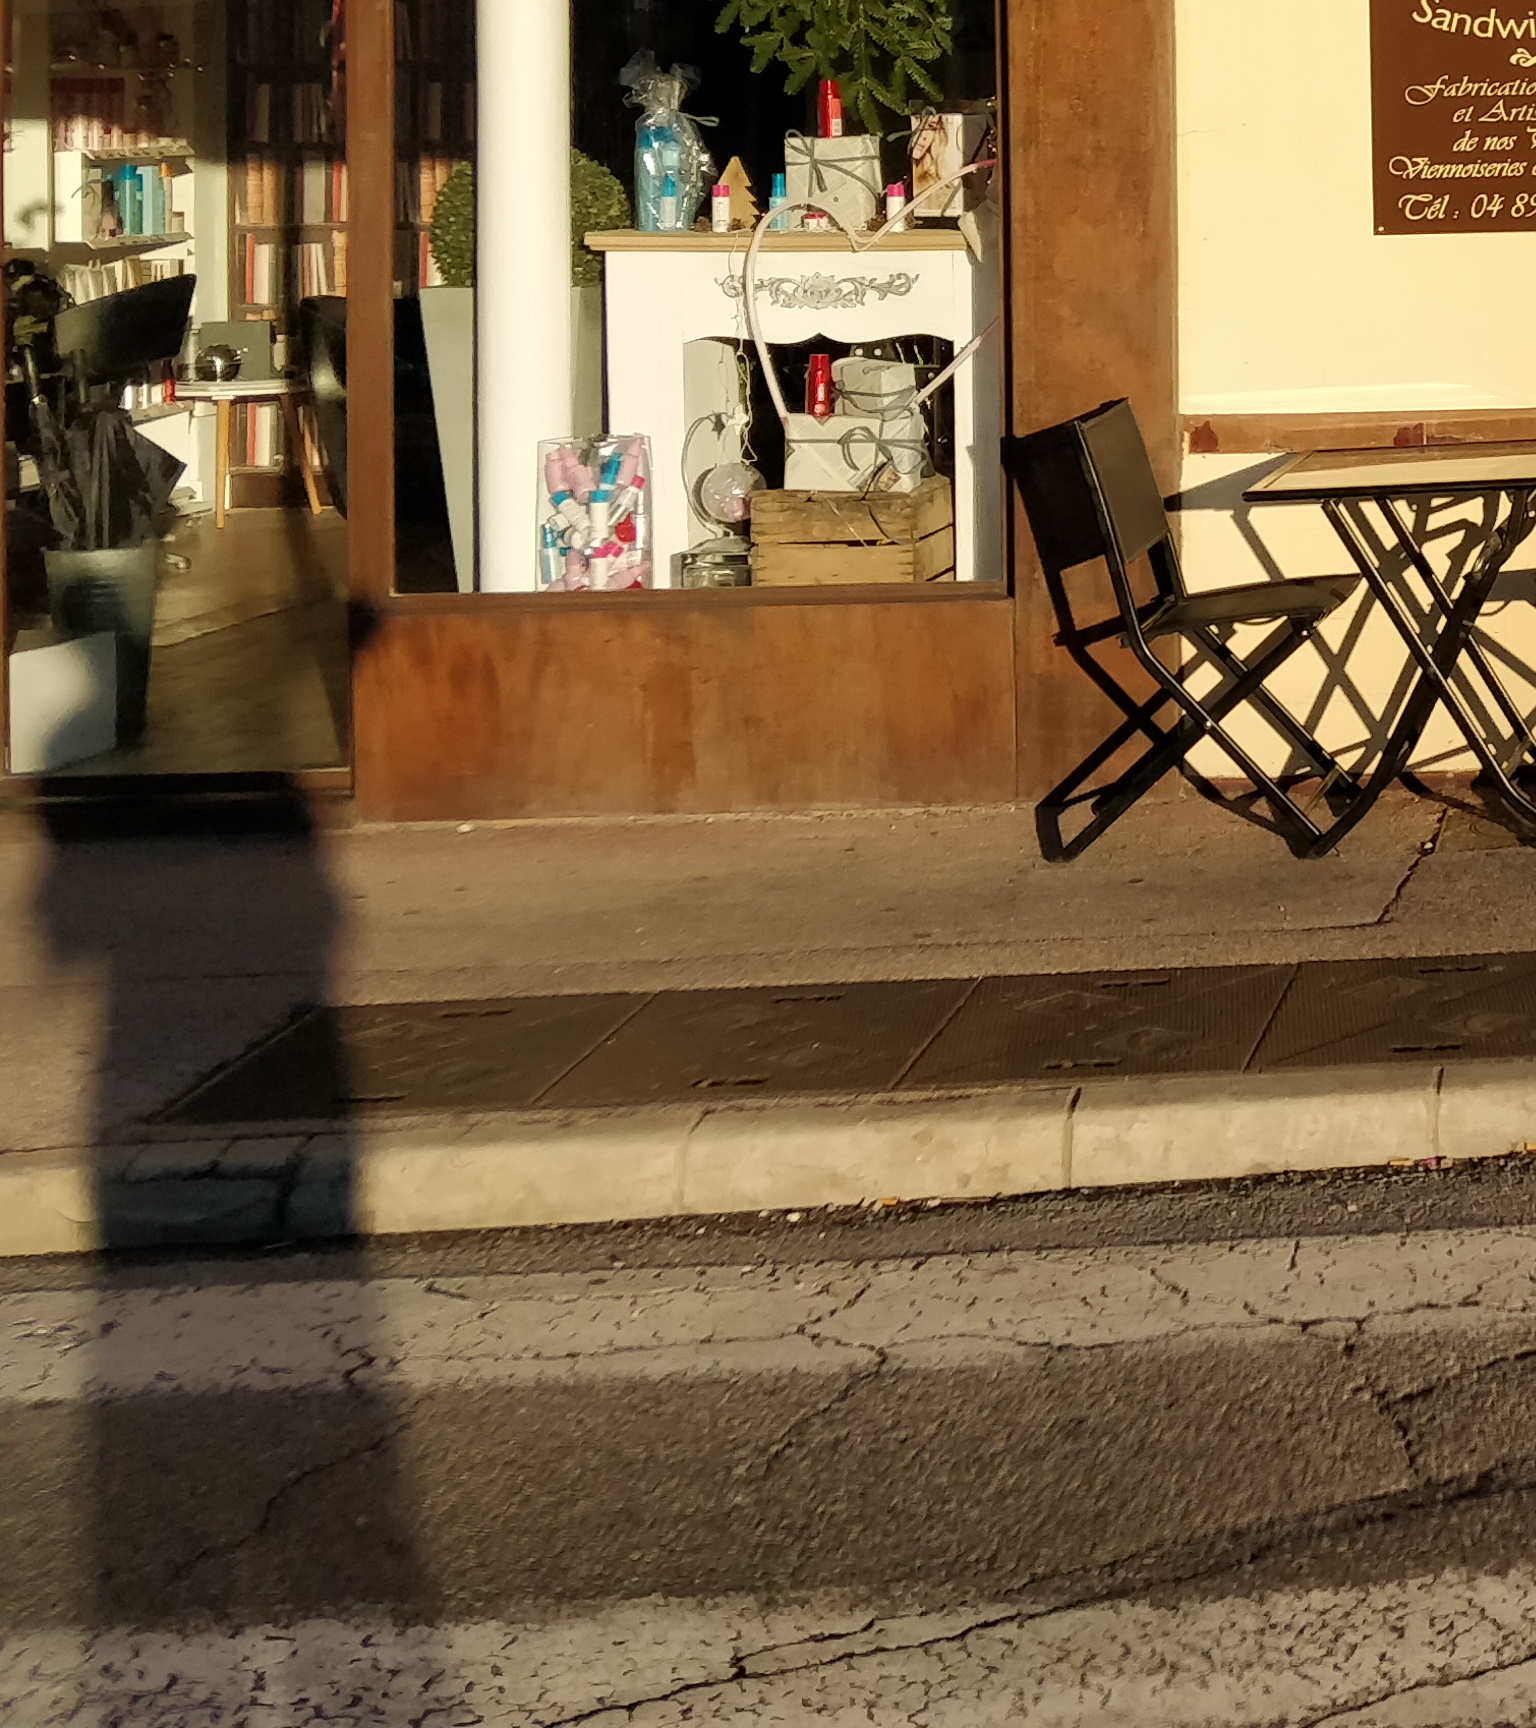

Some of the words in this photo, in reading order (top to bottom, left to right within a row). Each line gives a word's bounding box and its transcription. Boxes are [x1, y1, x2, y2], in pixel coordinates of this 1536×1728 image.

[1453, 105, 1473, 122] et
[1453, 130, 1478, 152] de
[1483, 135, 1517, 151] nos
[1389, 156, 1527, 180] Viennoiseries
[1470, 193, 1505, 218] 04
